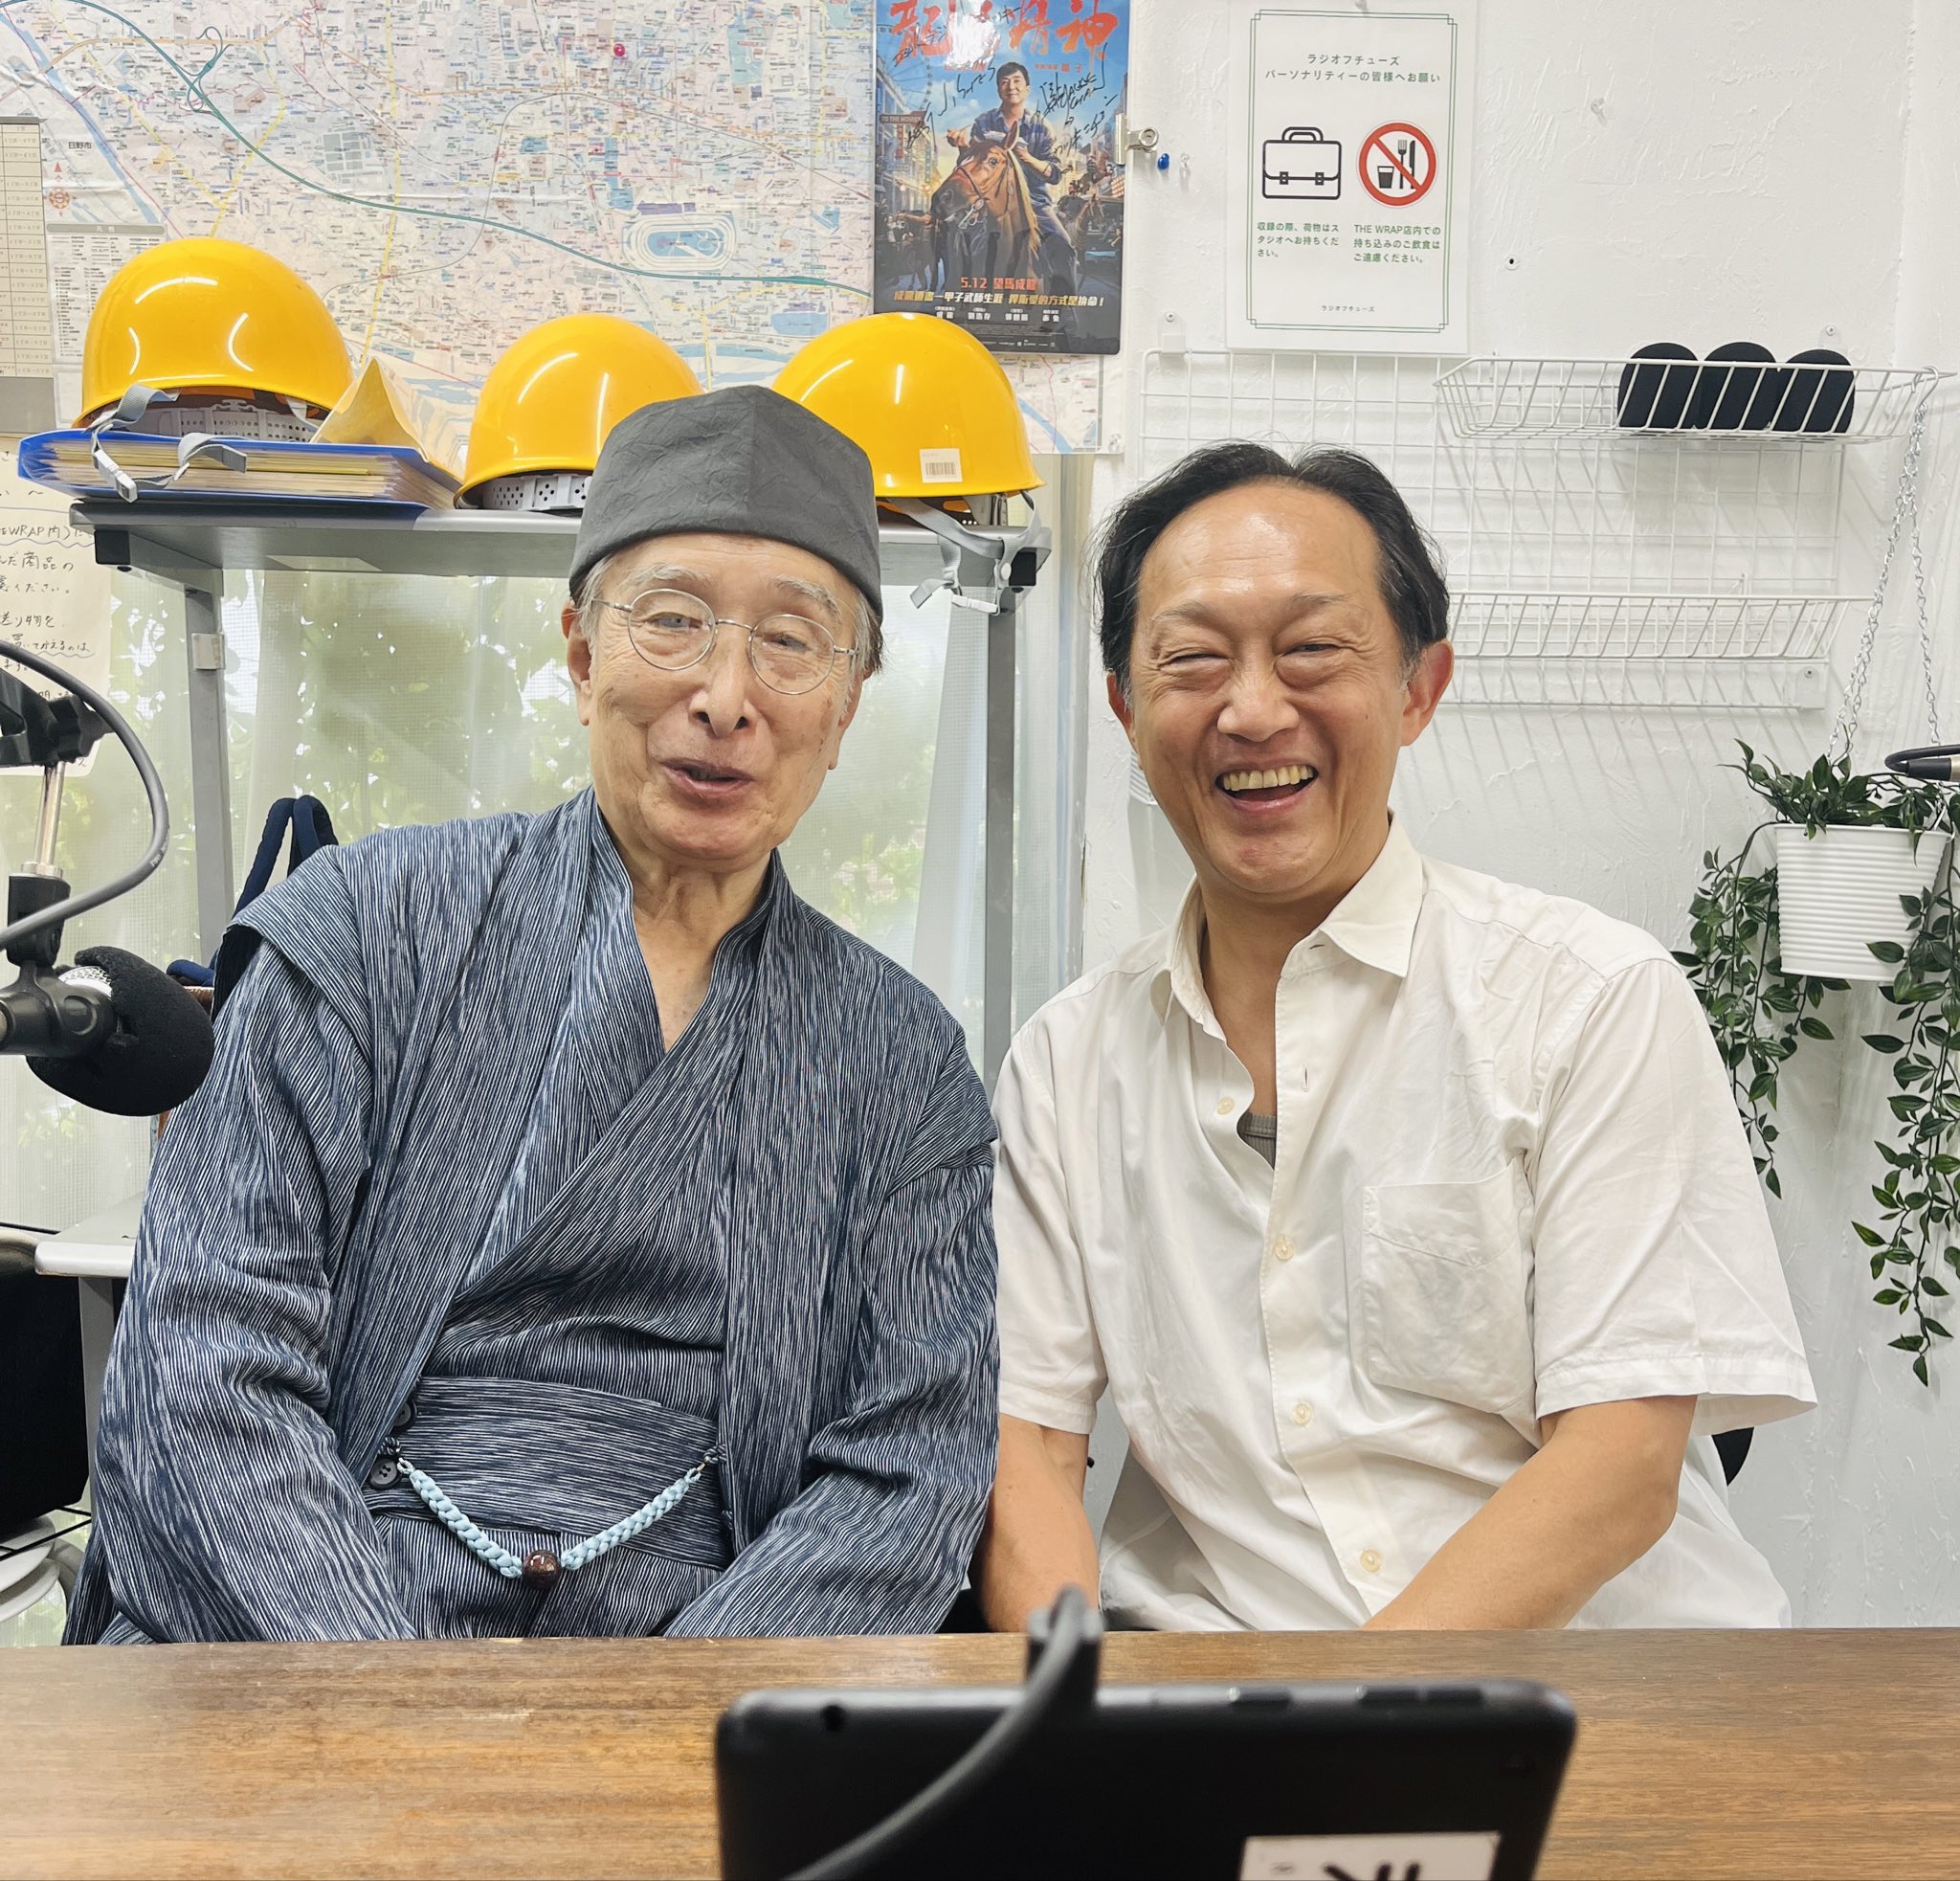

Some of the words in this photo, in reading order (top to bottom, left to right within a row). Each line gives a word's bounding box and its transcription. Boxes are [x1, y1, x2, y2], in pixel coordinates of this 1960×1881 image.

[1306, 54, 1400, 66] ラジオフチューズ
[1264, 69, 1440, 83] パーソナリティーの皆様へお願い
[68, 142, 92, 150] 日野市
[1257, 221, 1339, 233] 収録の際、荷物はス
[1354, 224, 1372, 234] THE
[1375, 224, 1441, 235] WRAP店内での
[1257, 235, 1339, 246] タジオへお持ちくだ
[1353, 238, 1440, 250] 持ち込みのご飲食は
[1257, 249, 1279, 258] さい。
[960, 278, 988, 289] 5.12
